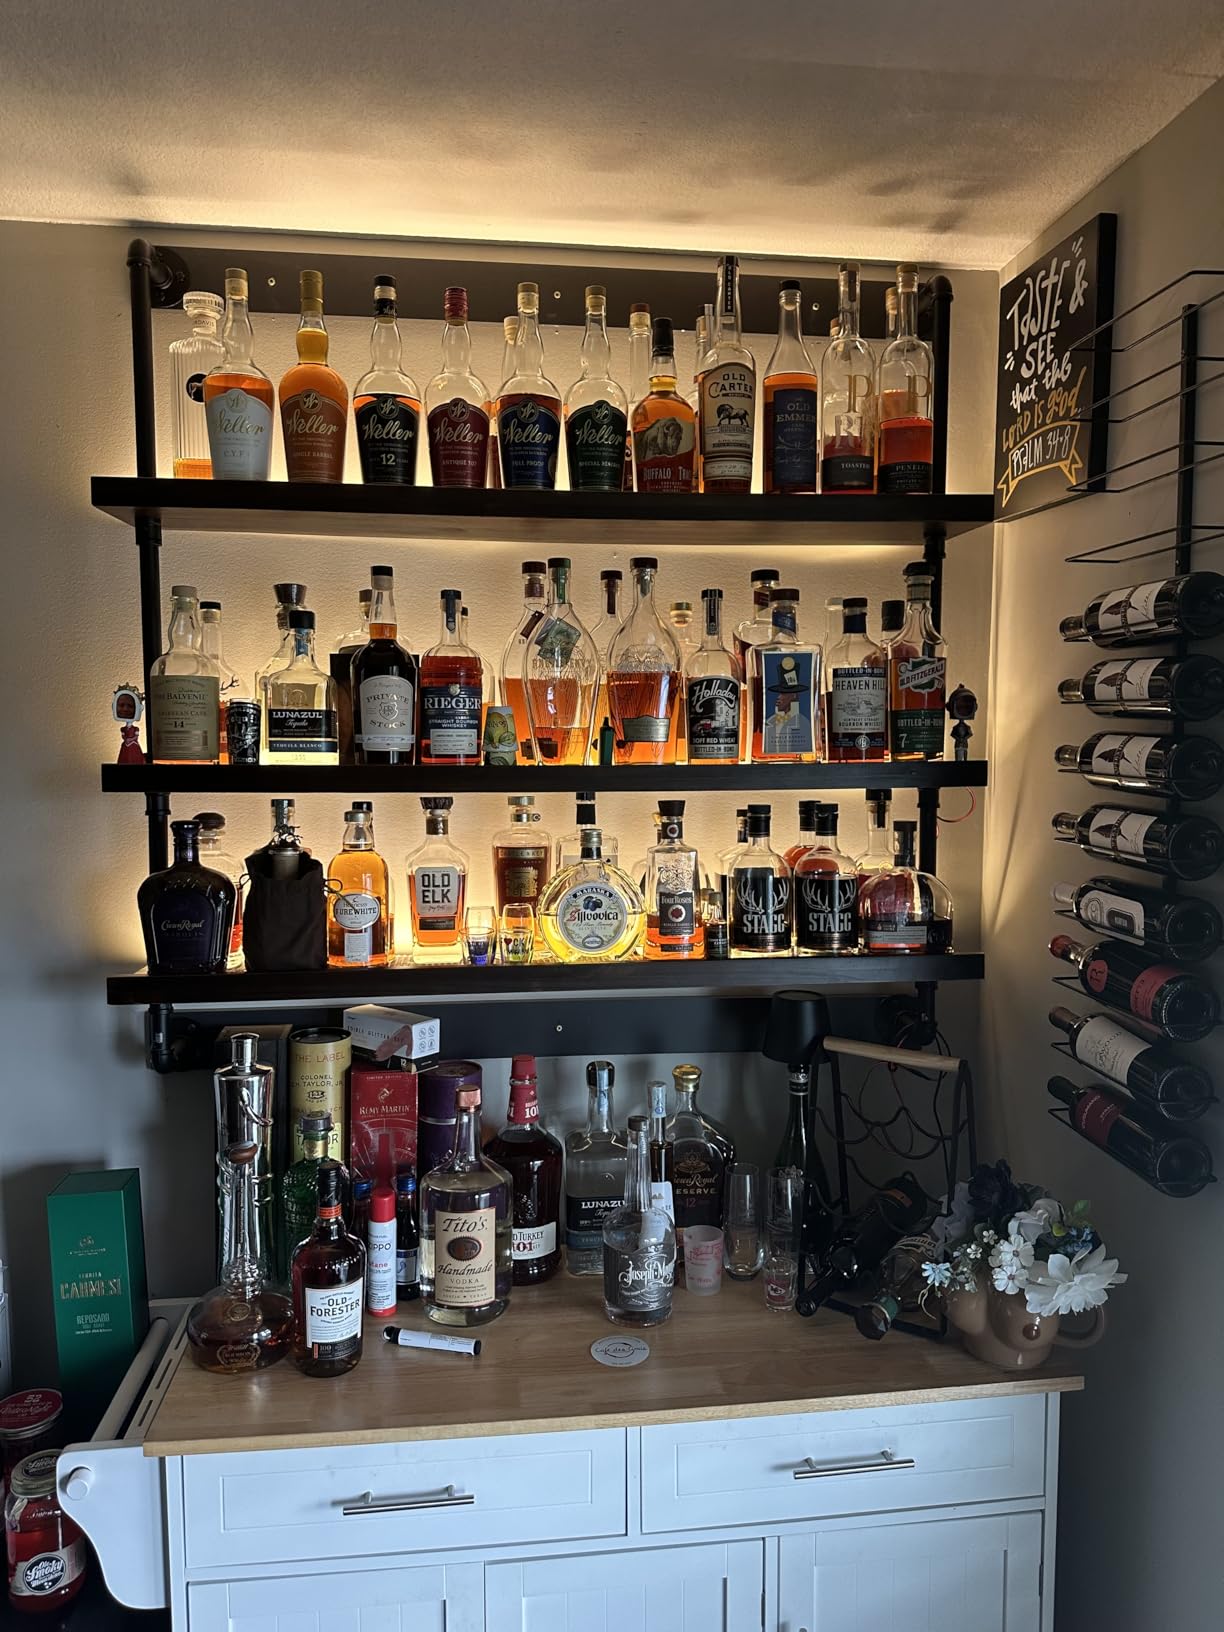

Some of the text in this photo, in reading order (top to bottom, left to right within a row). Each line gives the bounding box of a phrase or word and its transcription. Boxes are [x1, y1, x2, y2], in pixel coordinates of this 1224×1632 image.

[1020, 332, 1056, 379] SEE
[722, 372, 746, 381] OLD
[708, 381, 753, 398] CARTER
[1009, 381, 1038, 413] that
[1046, 365, 1087, 425] good
[787, 403, 810, 411] OLD
[287, 408, 338, 435] Weller
[362, 414, 415, 441] Weller
[434, 419, 484, 443] Weller
[502, 419, 554, 444] Weller
[575, 419, 623, 445] Weller
[380, 453, 396, 465] 12
[642, 467, 672, 481] BUFFALO
[835, 679, 885, 691] HEAVEN HILL
[366, 693, 409, 705] PRIVATE
[691, 679, 737, 707] Holladay
[423, 697, 482, 710] RIEGER
[271, 711, 323, 719] LUNAZUL
[368, 719, 406, 729] STOCK
[898, 733, 908, 748] 7
[421, 873, 451, 888] OLD
[421, 889, 451, 904] ELK
[576, 887, 610, 898] MARASKA
[661, 895, 692, 904] Four Roses
[353, 907, 377, 916] WHITE
[742, 913, 785, 934] STAGG
[808, 912, 852, 933] STAGG
[296, 1051, 345, 1063] THE LABEL
[380, 1104, 410, 1113] MARTIN
[296, 1134, 339, 1145] TAOR
[675, 1187, 719, 1195] ESERVE
[442, 1216, 488, 1233] Tito's
[517, 1230, 544, 1242] TURKEY
[437, 1259, 493, 1276] Handmade
[618, 1260, 656, 1288] Joseph
[310, 1298, 360, 1317] FORESTER
[328, 1296, 347, 1307] OLD
[76, 1312, 111, 1325] REPOSADO
[25, 1559, 64, 1582] Smoky
